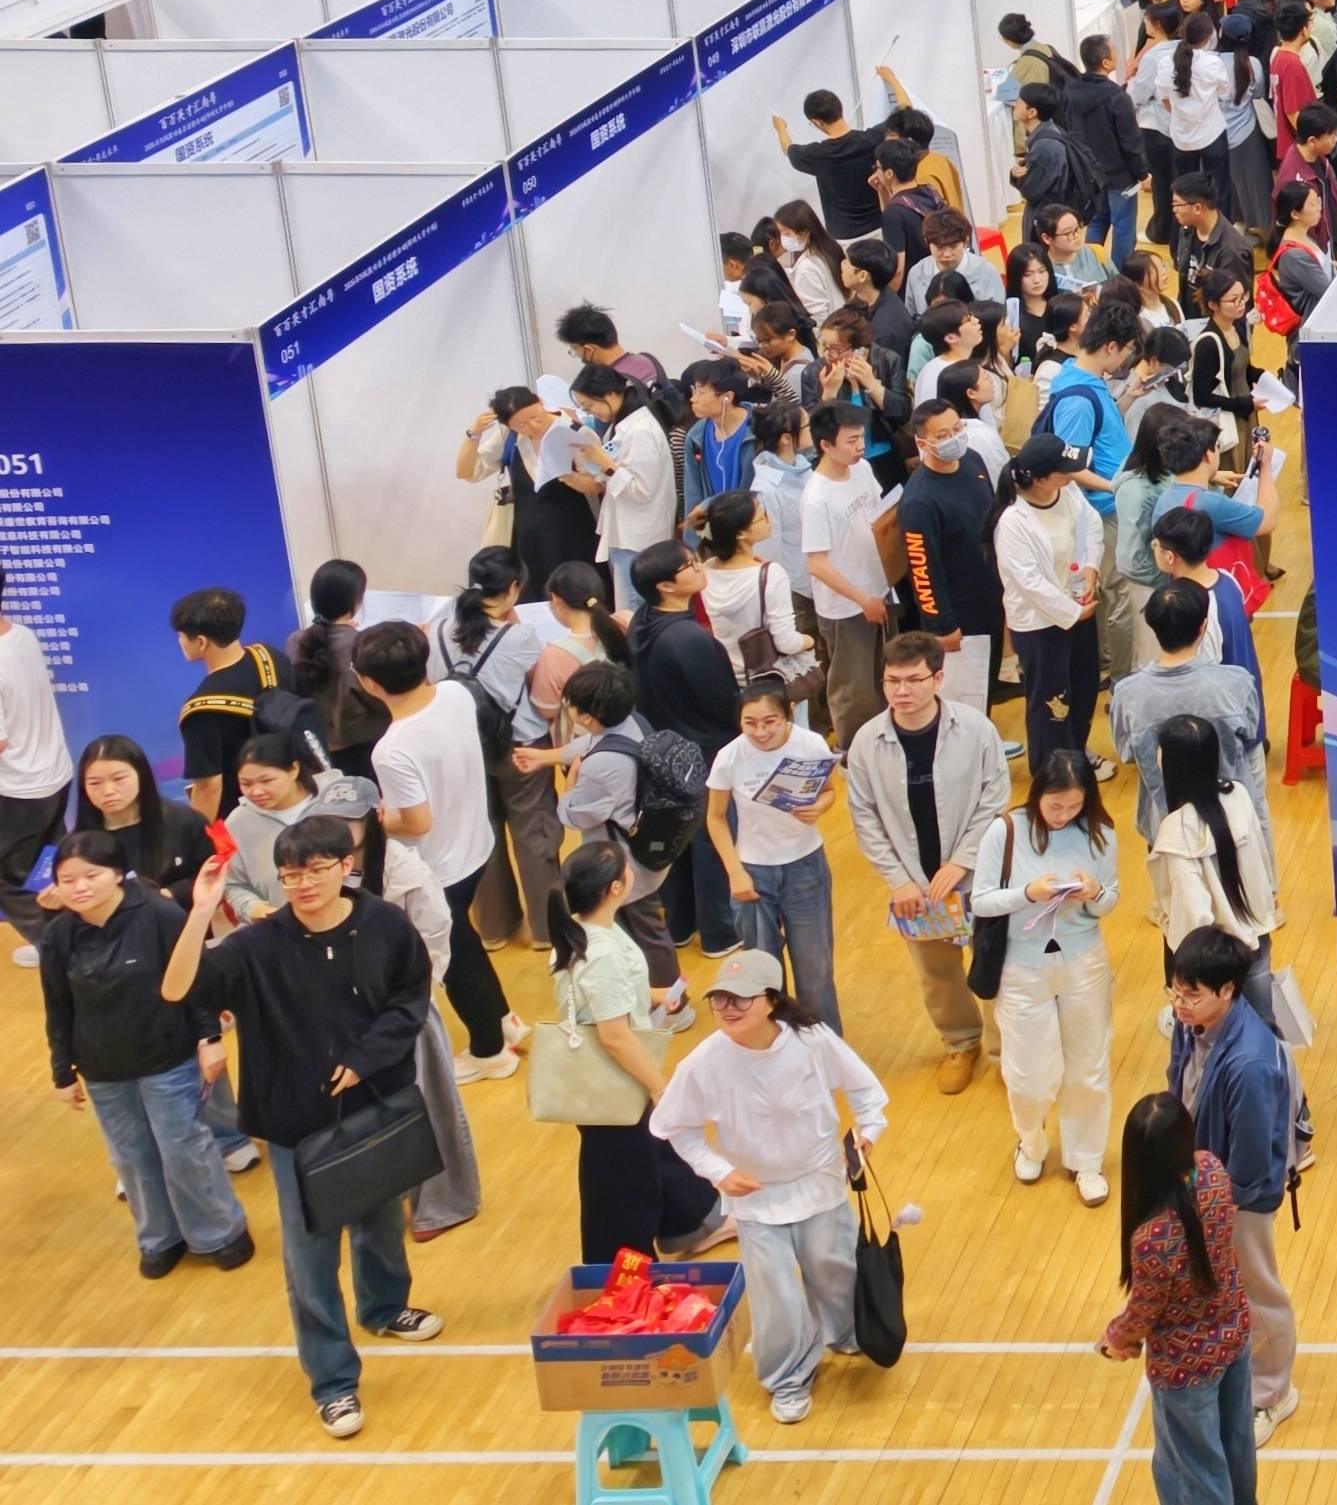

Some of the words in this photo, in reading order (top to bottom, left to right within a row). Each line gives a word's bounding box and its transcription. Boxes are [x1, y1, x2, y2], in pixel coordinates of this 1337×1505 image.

[590, 112, 627, 151] 国资系统
[522, 175, 537, 195] 050
[371, 256, 420, 304] 国资系统
[280, 340, 301, 364] 051
[905, 531, 939, 615] ANTAUNI
